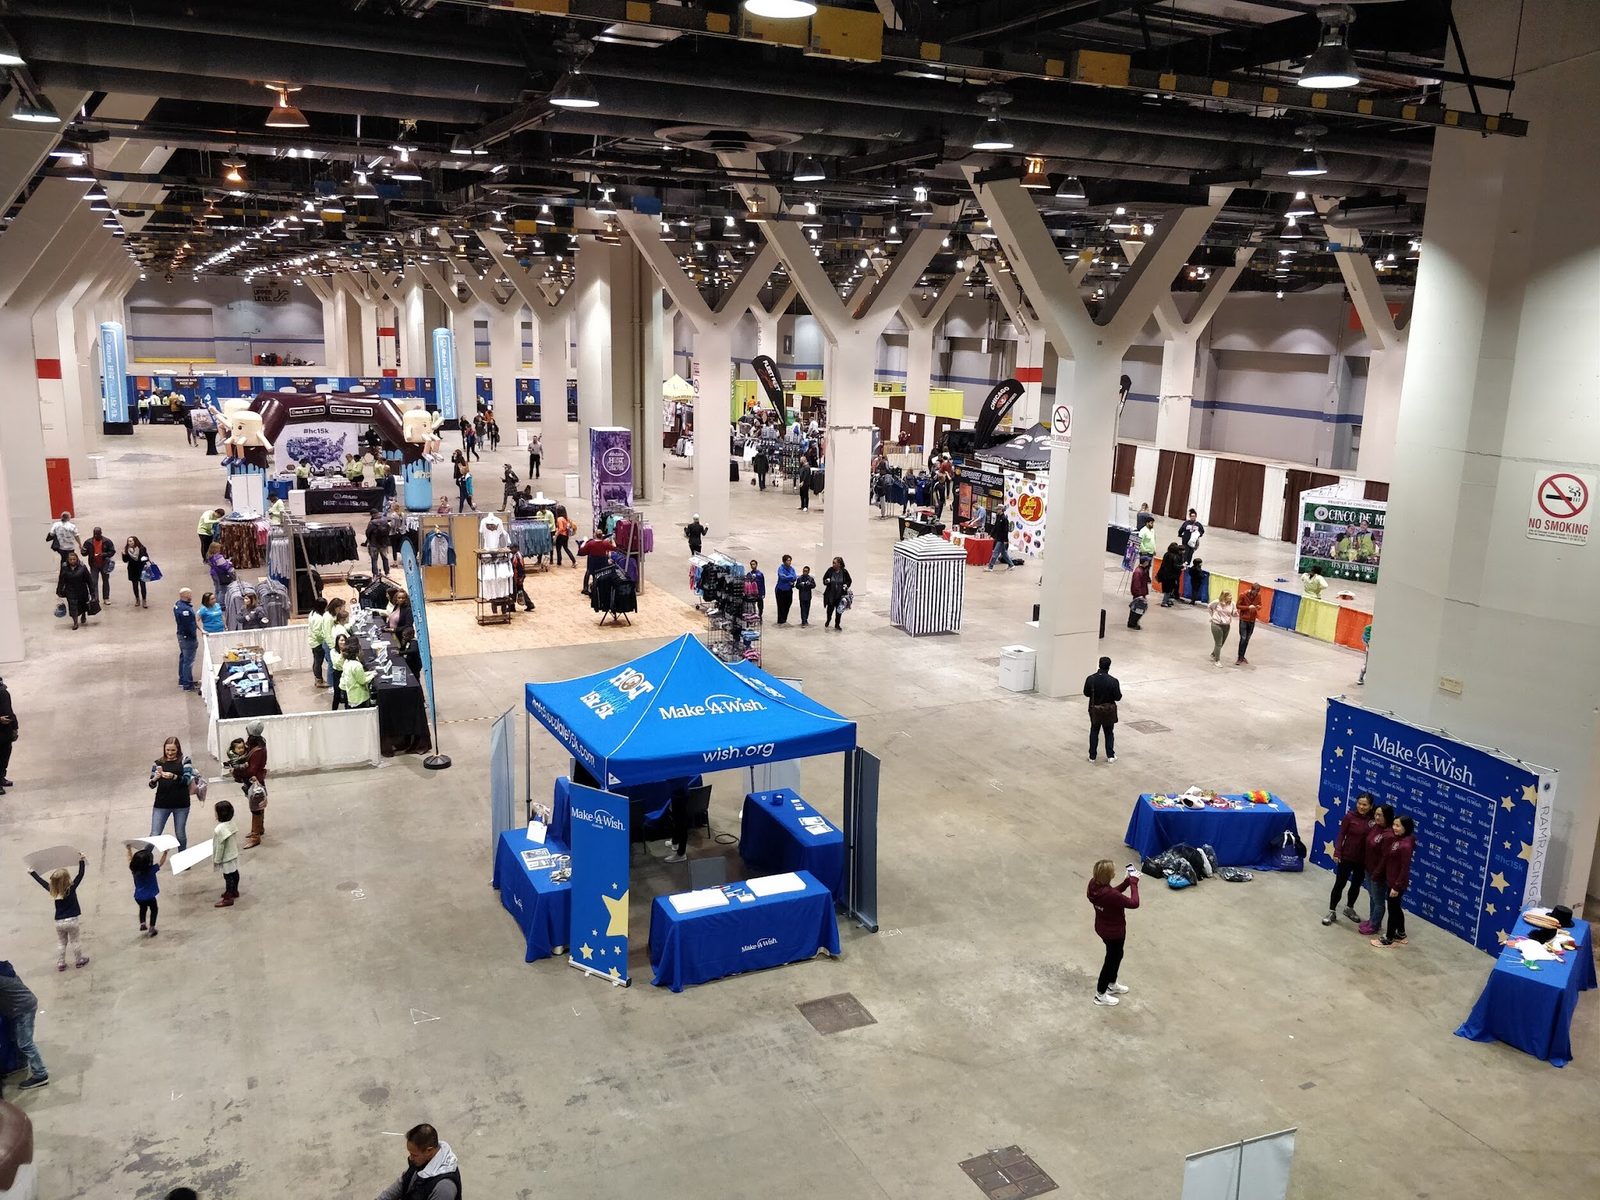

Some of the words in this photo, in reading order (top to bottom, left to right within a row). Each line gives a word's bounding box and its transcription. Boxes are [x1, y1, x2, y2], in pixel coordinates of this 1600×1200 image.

[990, 386, 1010, 411] CHICAGO
[1328, 508, 1356, 522] CINCO
[1359, 512, 1372, 524] DE
[1528, 518, 1542, 528] NO
[1544, 520, 1588, 535] SMOKING
[609, 667, 655, 701] HOT
[703, 742, 775, 763] wish.org
[571, 806, 626, 831] Make-A-Wish
[1494, 854, 1524, 872] #hc15k
[742, 937, 778, 952] Make-A-Wish
